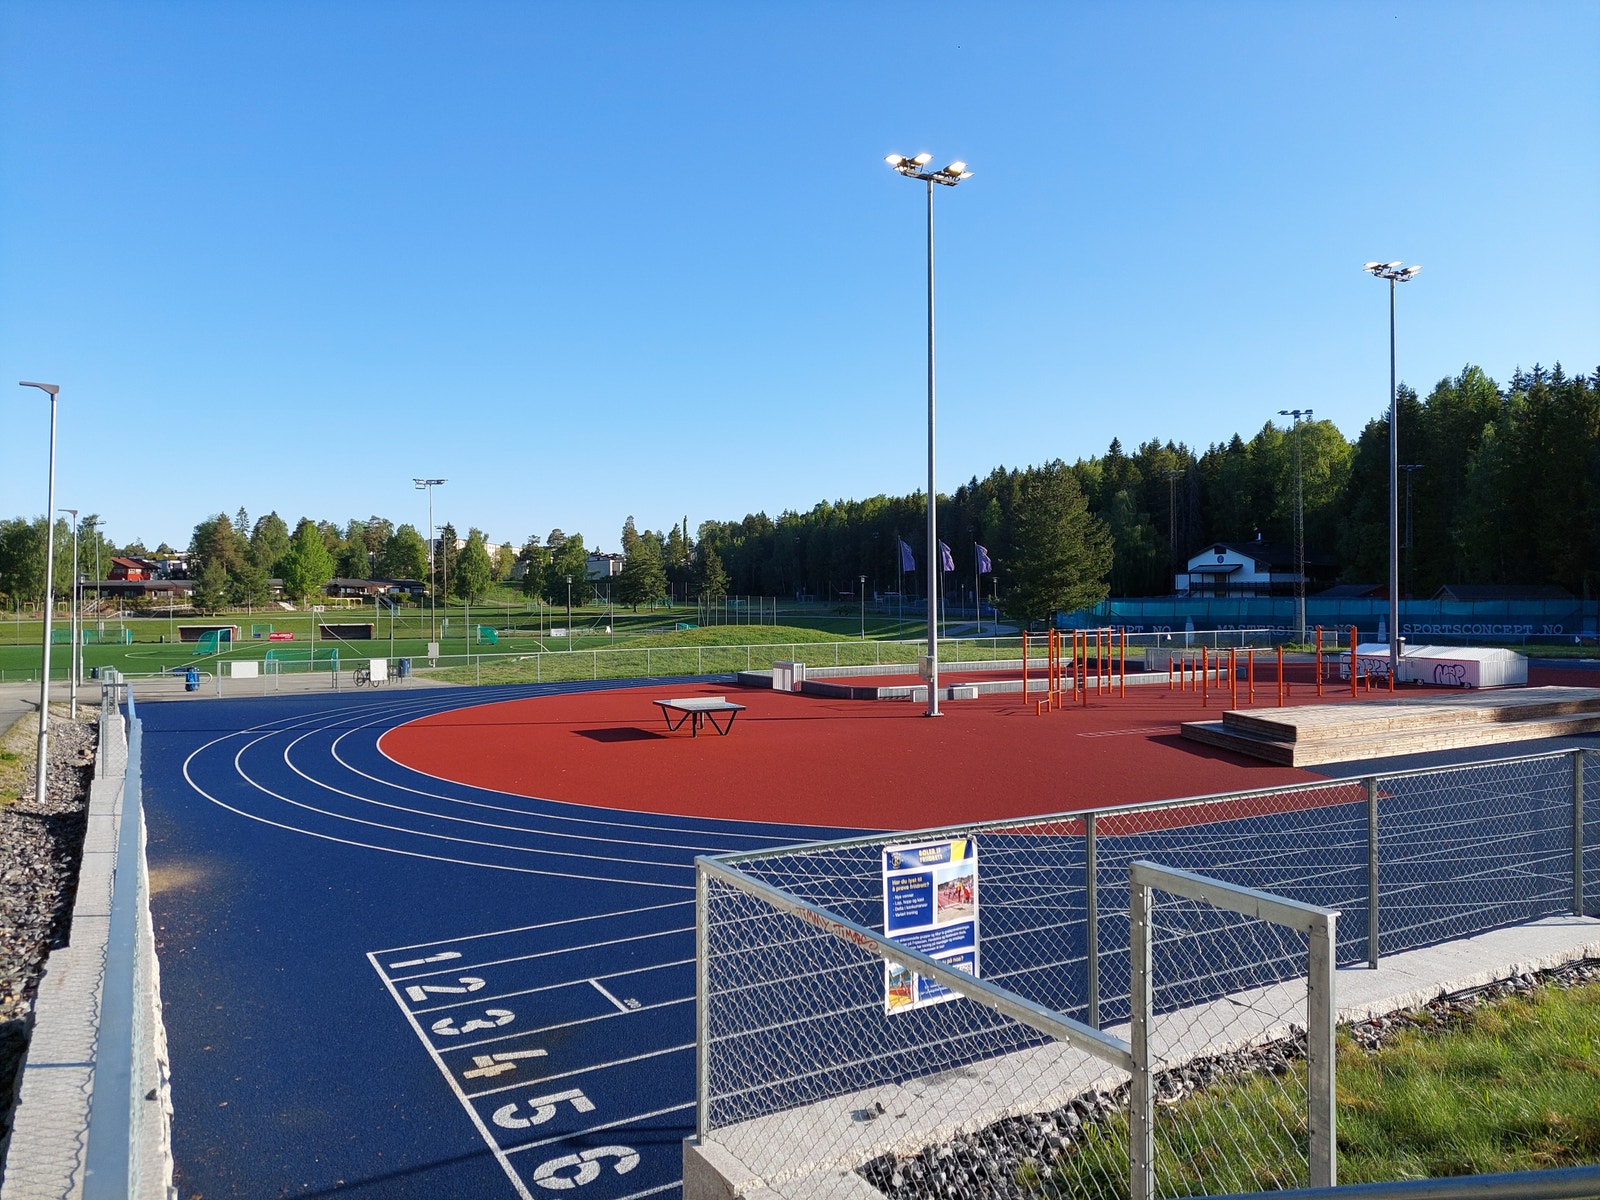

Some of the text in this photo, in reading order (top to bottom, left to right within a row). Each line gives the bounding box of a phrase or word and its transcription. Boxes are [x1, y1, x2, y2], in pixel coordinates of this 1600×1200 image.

[389, 951, 462, 969] 1
[405, 977, 486, 1002] 2
[431, 1009, 516, 1036] 3
[463, 1049, 549, 1080] 4
[492, 1088, 597, 1129] 5
[533, 1145, 641, 1190] 6
